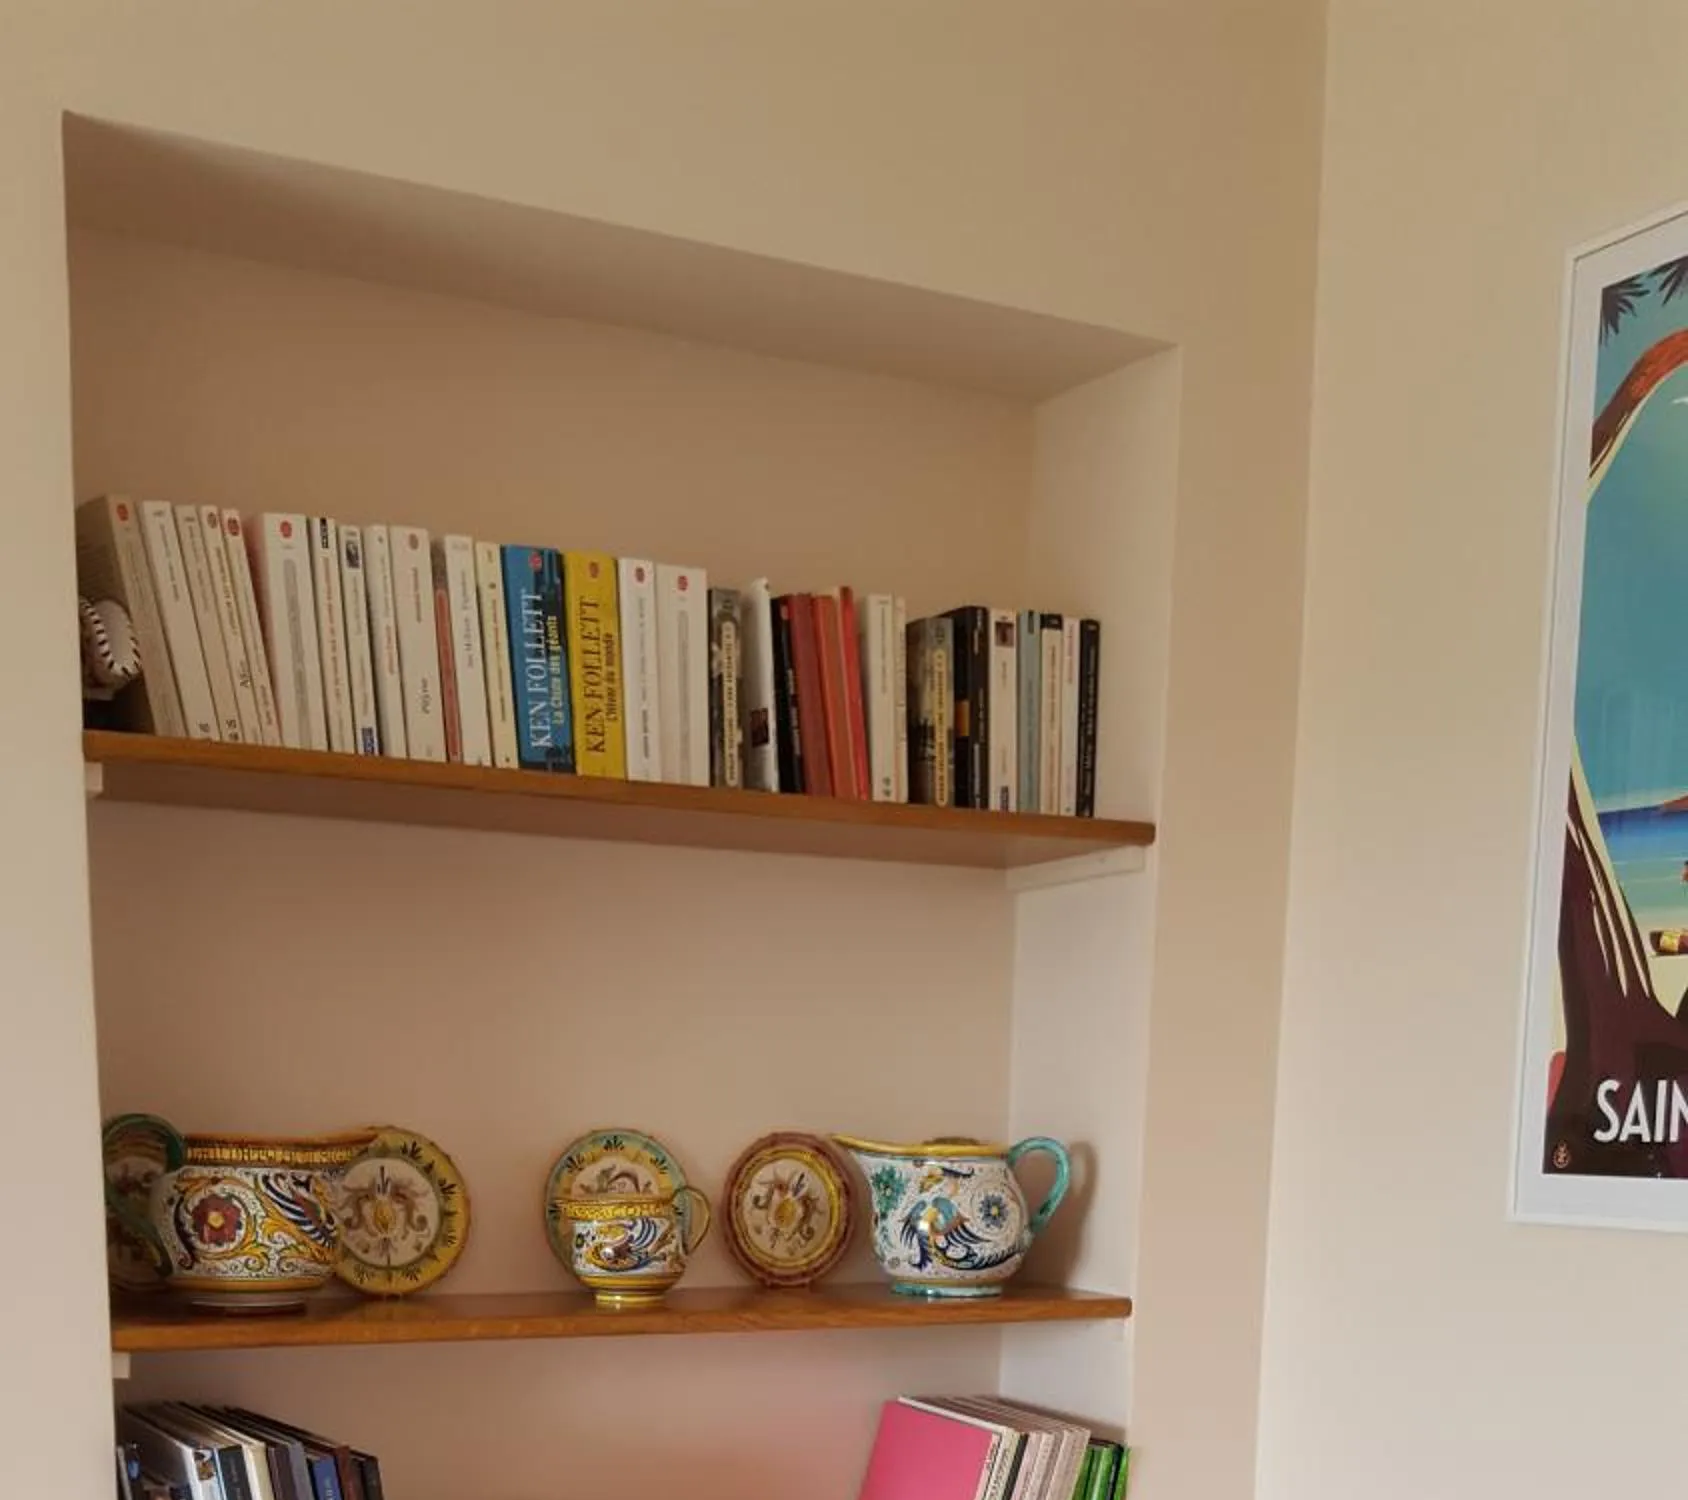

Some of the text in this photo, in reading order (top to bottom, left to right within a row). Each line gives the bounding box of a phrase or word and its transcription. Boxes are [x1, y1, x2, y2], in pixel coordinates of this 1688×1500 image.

[521, 589, 552, 748] KEN FOLLETT
[580, 595, 606, 753] KEN FOLLETT
